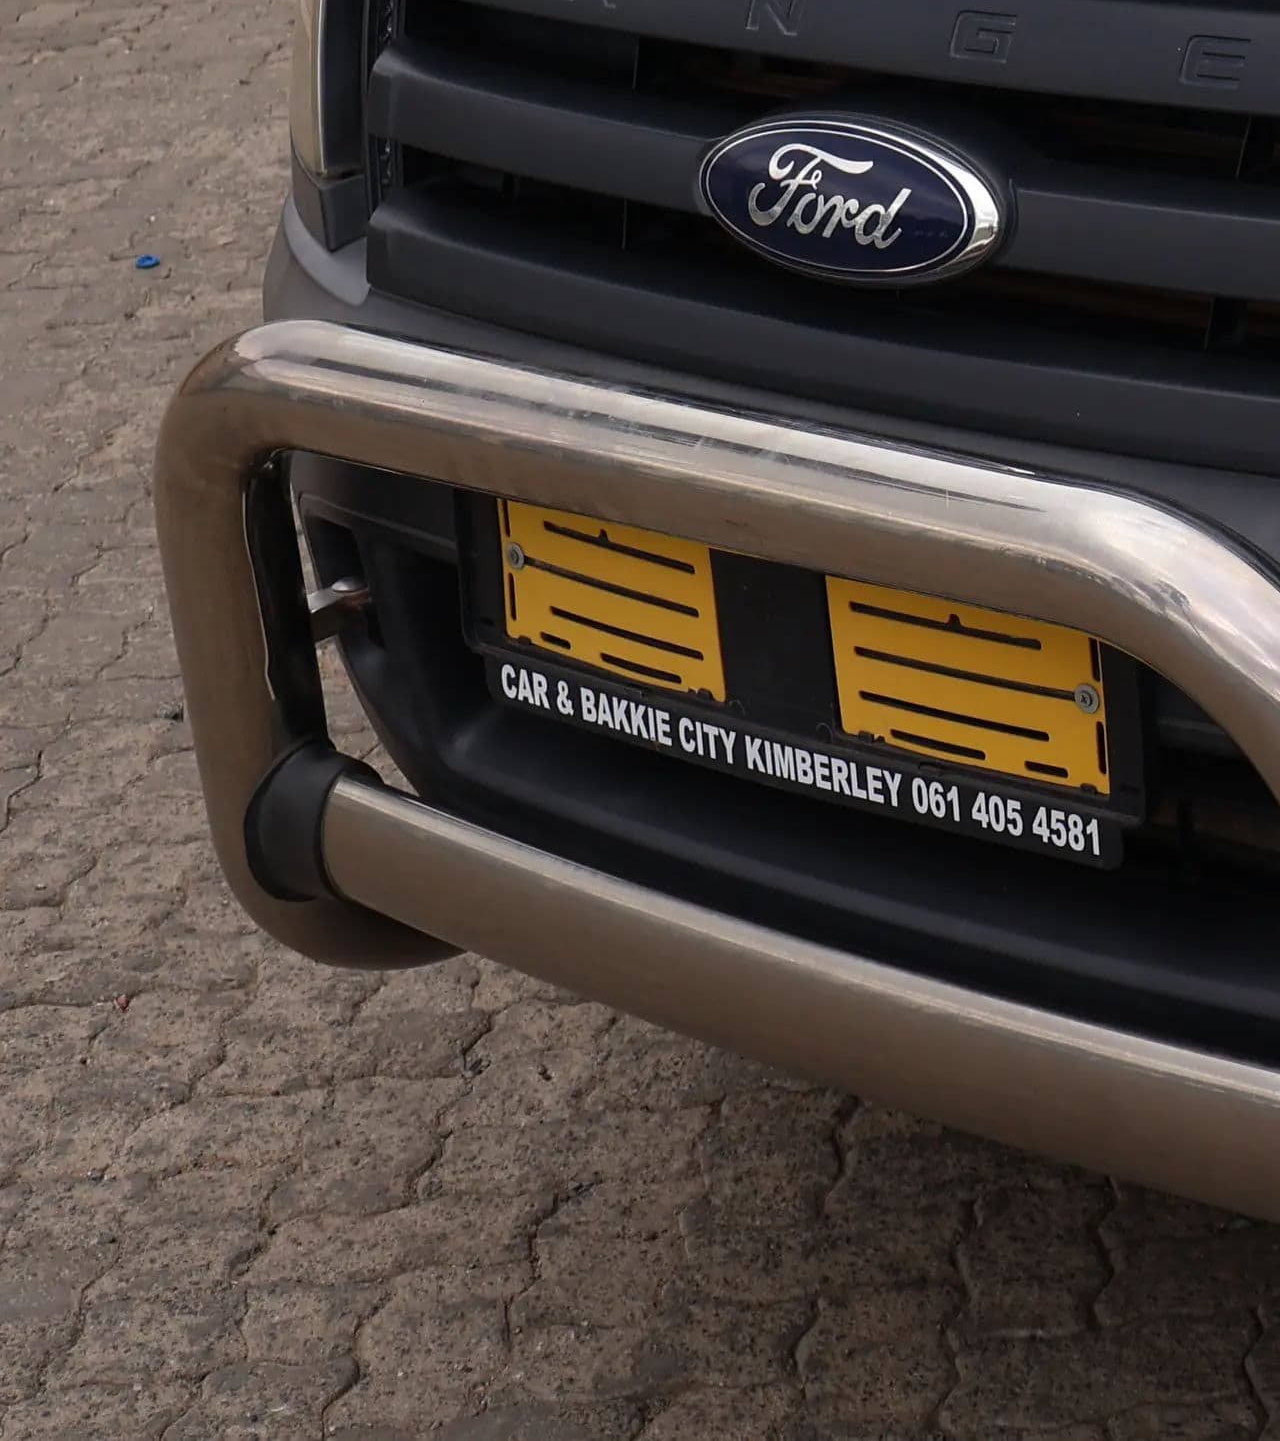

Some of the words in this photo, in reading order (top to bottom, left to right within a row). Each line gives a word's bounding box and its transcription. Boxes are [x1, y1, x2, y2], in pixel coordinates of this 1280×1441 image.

[748, 142, 911, 250] Ford
[501, 664, 550, 709] CAR
[556, 680, 574, 716] &
[580, 687, 672, 746] BAKKIE
[679, 717, 736, 764] CITY
[745, 735, 902, 807] KIMBERLEY
[912, 777, 960, 822] 061
[971, 792, 1023, 836] 405
[1032, 806, 1101, 856] 4581
